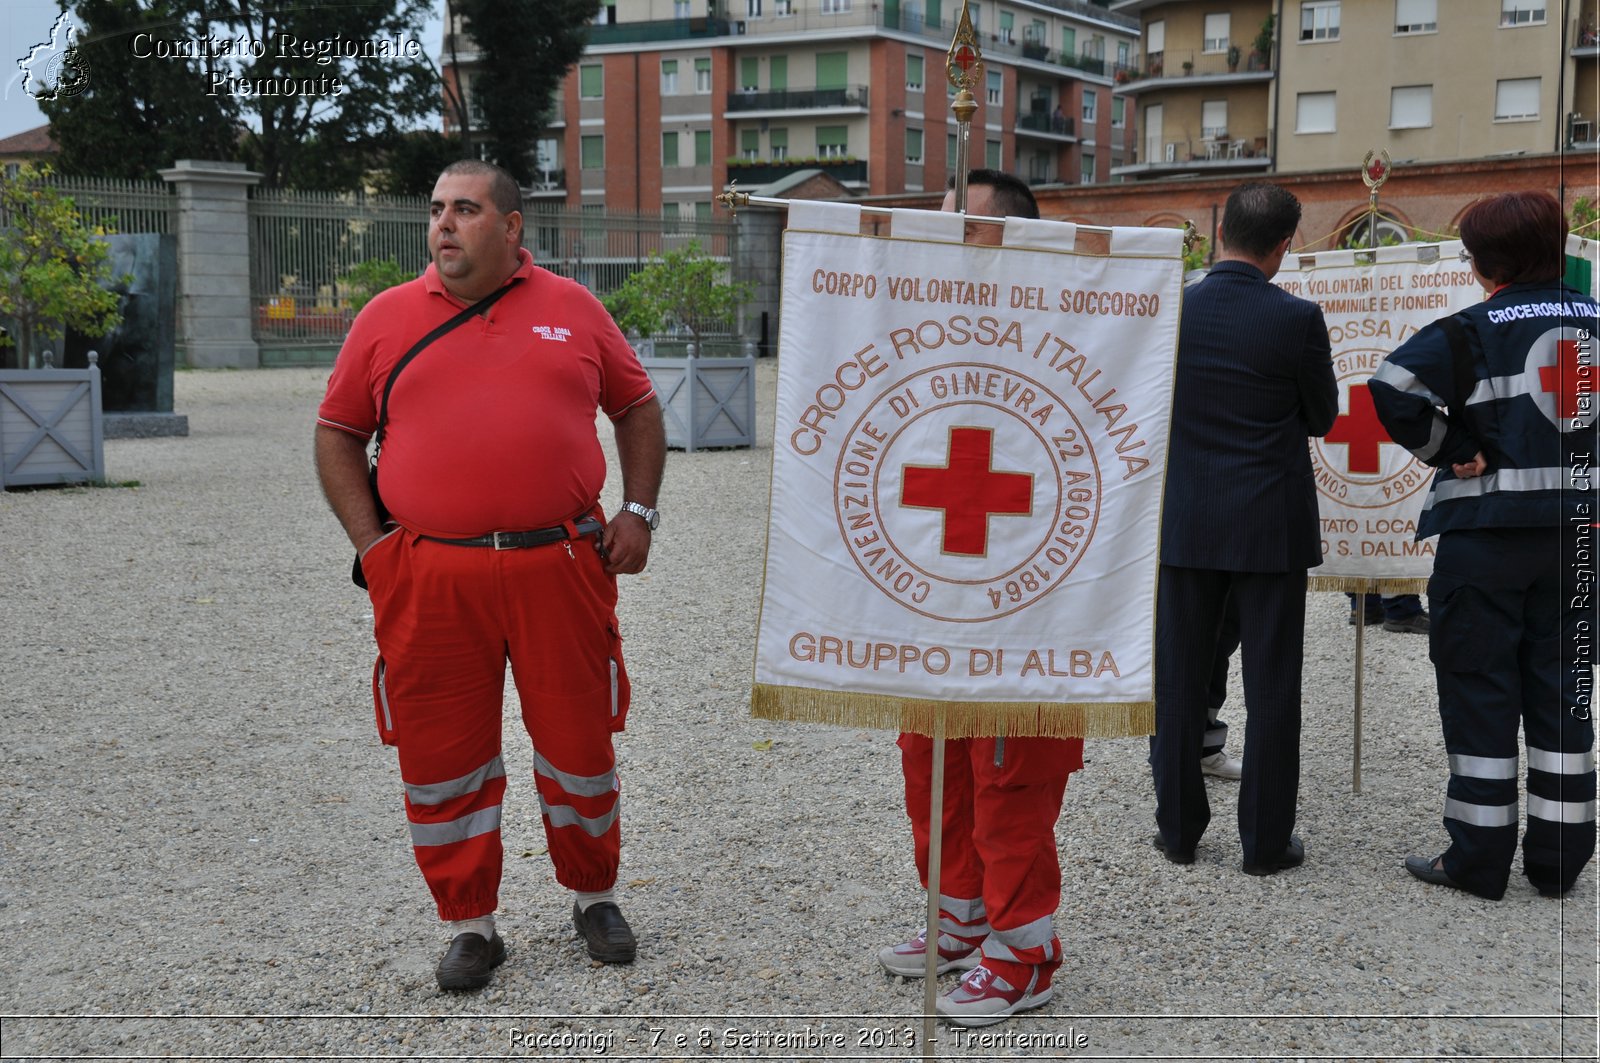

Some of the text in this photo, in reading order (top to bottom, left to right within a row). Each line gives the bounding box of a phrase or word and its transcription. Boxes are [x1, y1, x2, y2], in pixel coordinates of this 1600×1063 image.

[812, 268, 1160, 318] CORPO VOLONTARI DEL SOCCORSO
[1308, 277, 1373, 295] VOLONTARI
[1380, 275, 1404, 290] DEL
[1411, 271, 1475, 289] SOCCORSO
[1380, 297, 1389, 312] E
[1393, 293, 1448, 311] PIONIERI
[1328, 318, 1391, 343] OSSA
[790, 314, 1151, 481] CROCE ROSSA ITALIANA
[1337, 353, 1382, 372] GINE
[1382, 469, 1422, 499] 1864
[844, 371, 1093, 610] CONVENZIONE DI GINEVRA 22 AGOSTO 1864
[1320, 519, 1417, 534] TATO LOCA
[1337, 540, 1353, 556] S.
[1361, 541, 1435, 556] DALMA
[788, 631, 1121, 679] GRUPPO DI ALBA
